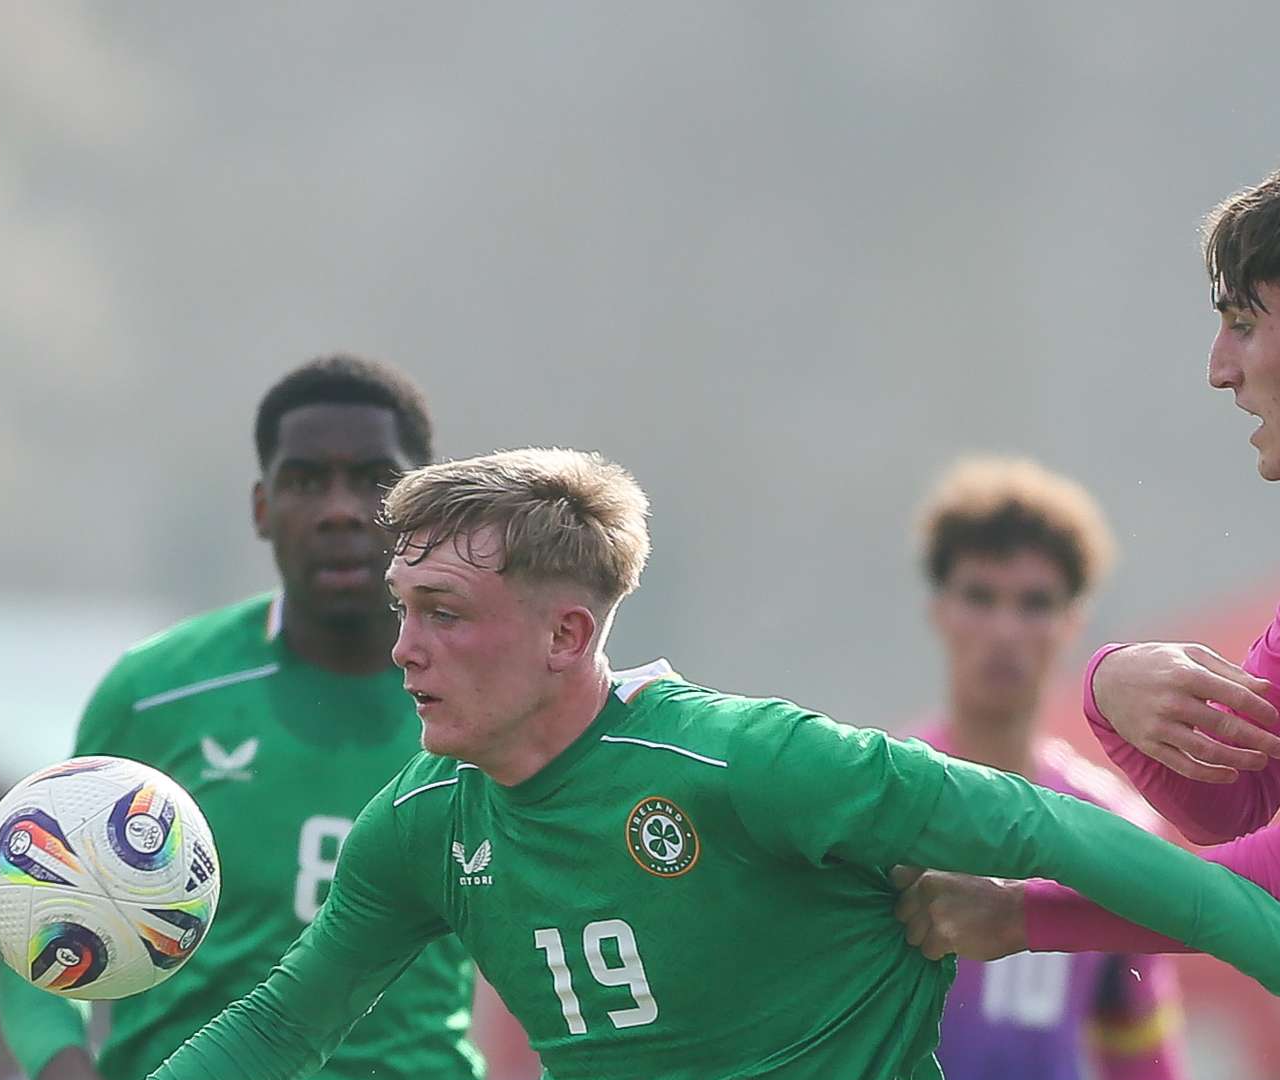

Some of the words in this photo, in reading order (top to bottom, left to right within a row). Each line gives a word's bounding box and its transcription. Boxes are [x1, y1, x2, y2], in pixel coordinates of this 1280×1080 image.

[294, 815, 353, 922] 8
[631, 801, 683, 832] IRELAND
[534, 918, 658, 1034] 19
